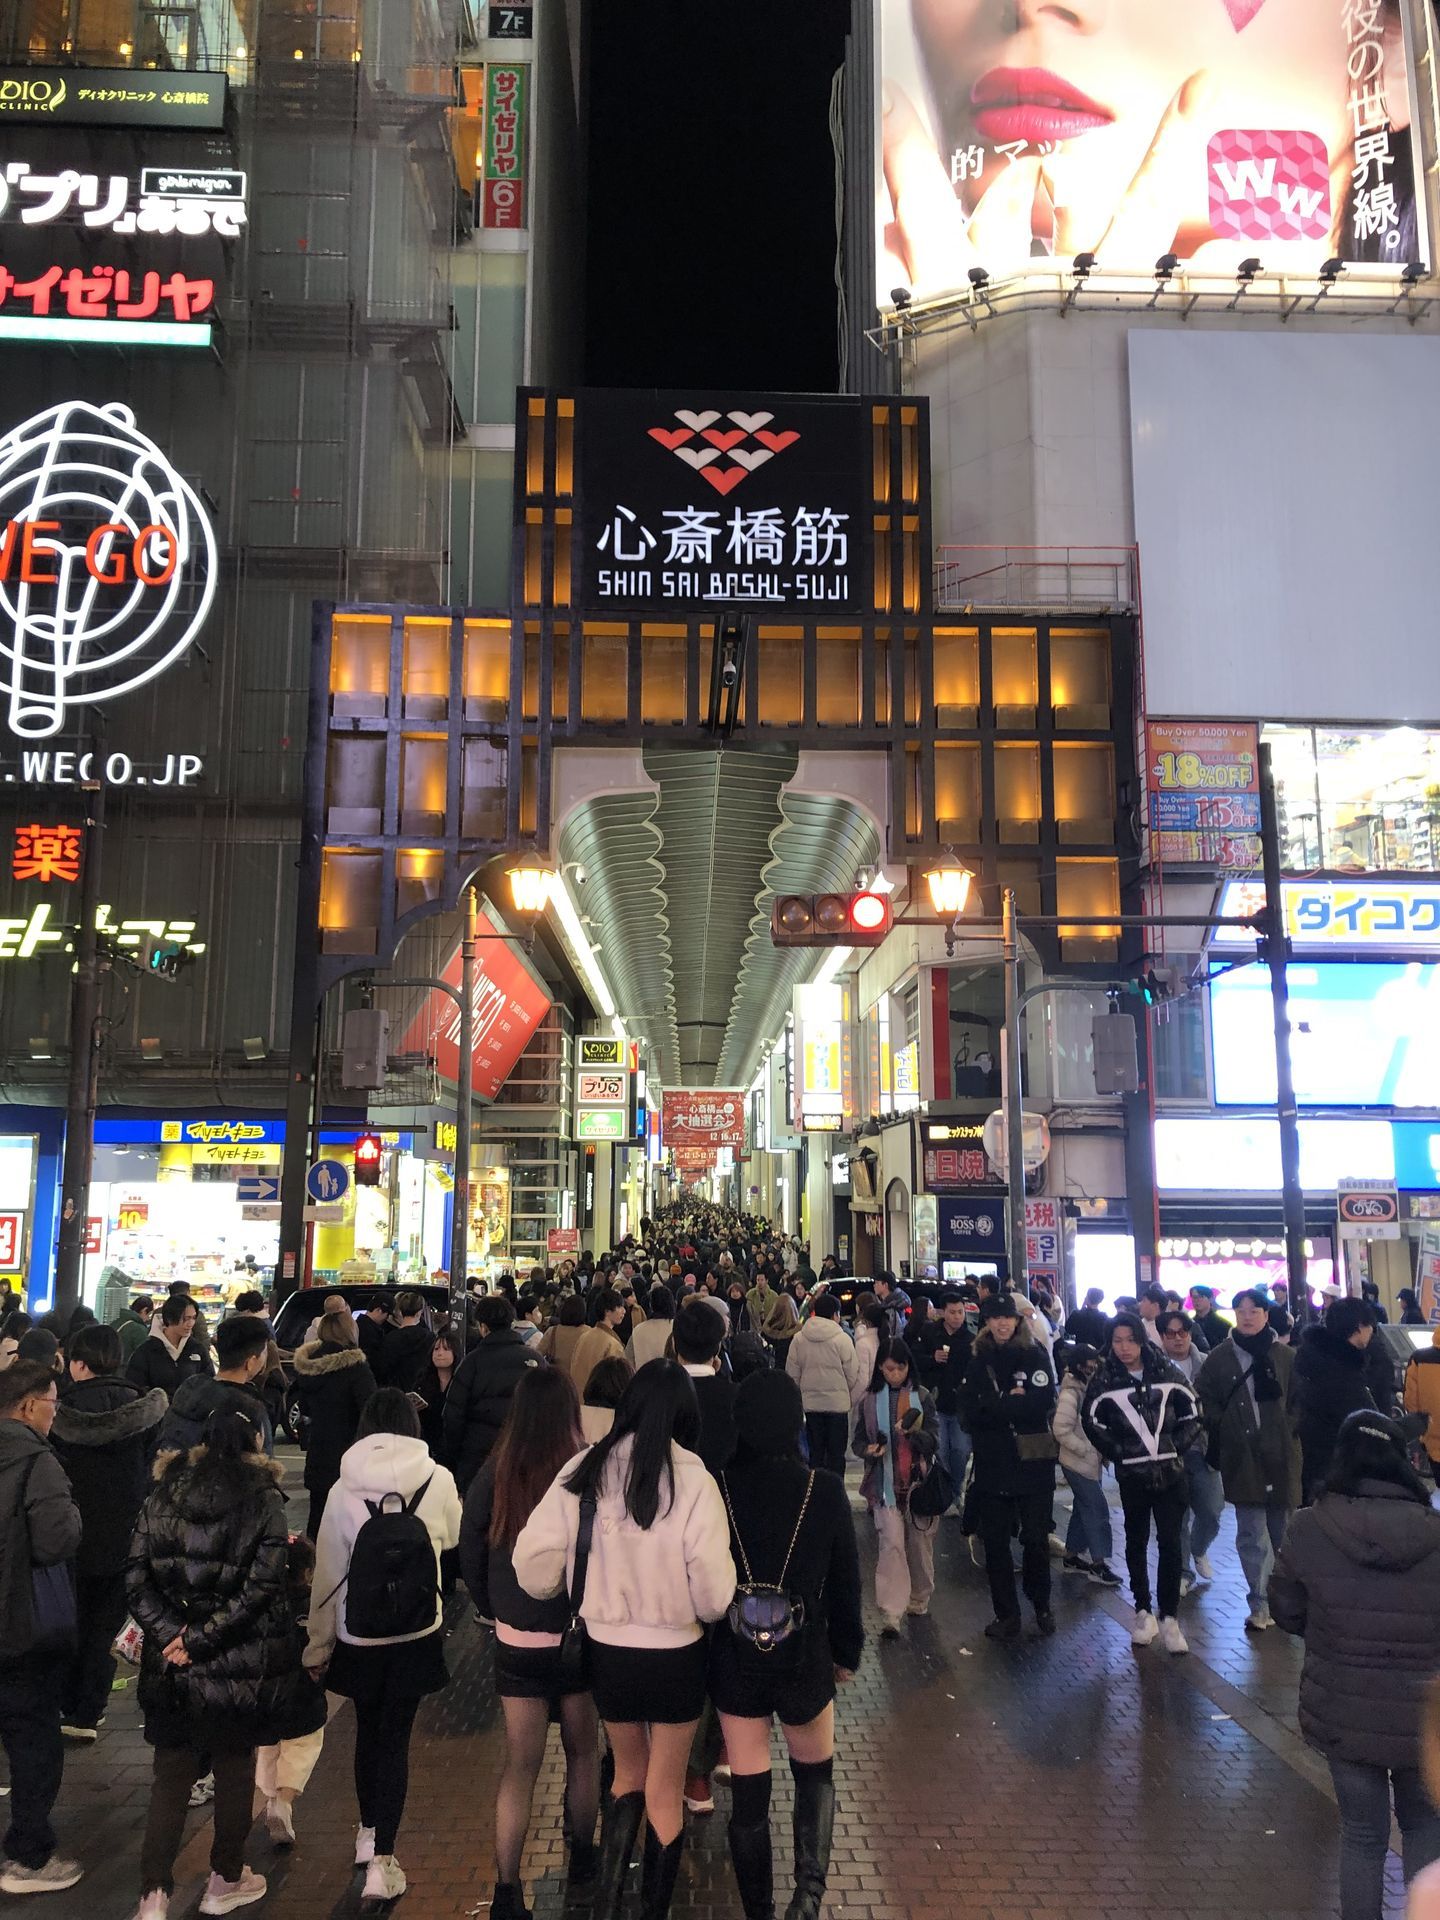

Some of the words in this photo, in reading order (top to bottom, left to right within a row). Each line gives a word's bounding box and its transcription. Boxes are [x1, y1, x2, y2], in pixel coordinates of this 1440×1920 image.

[499, 11, 524, 29] 7F
[0, 80, 51, 101] DIO
[77, 89, 157, 102] ディオクリニック
[0, 102, 48, 111] CLINIC
[494, 72, 517, 175] サイゼリヤ
[1341, 0, 1401, 250] 役の世界線。
[492, 181, 516, 227] 6F
[0, 265, 214, 321] イゼリヤ
[596, 503, 851, 567] 心斎橋筋
[598, 570, 651, 597] SHIN
[662, 572, 699, 598] SAI
[1175, 728, 1196, 737] Over
[1231, 728, 1248, 737] Yen
[12, 825, 82, 883] 薬
[590, 1043, 611, 1054] DIO
[187, 1121, 265, 1142] マツモトキヨシ
[206, 1146, 267, 1162] マツモトキヨシ
[950, 1219, 975, 1230] BOSS
[1039, 1235, 1055, 1263] 3F
